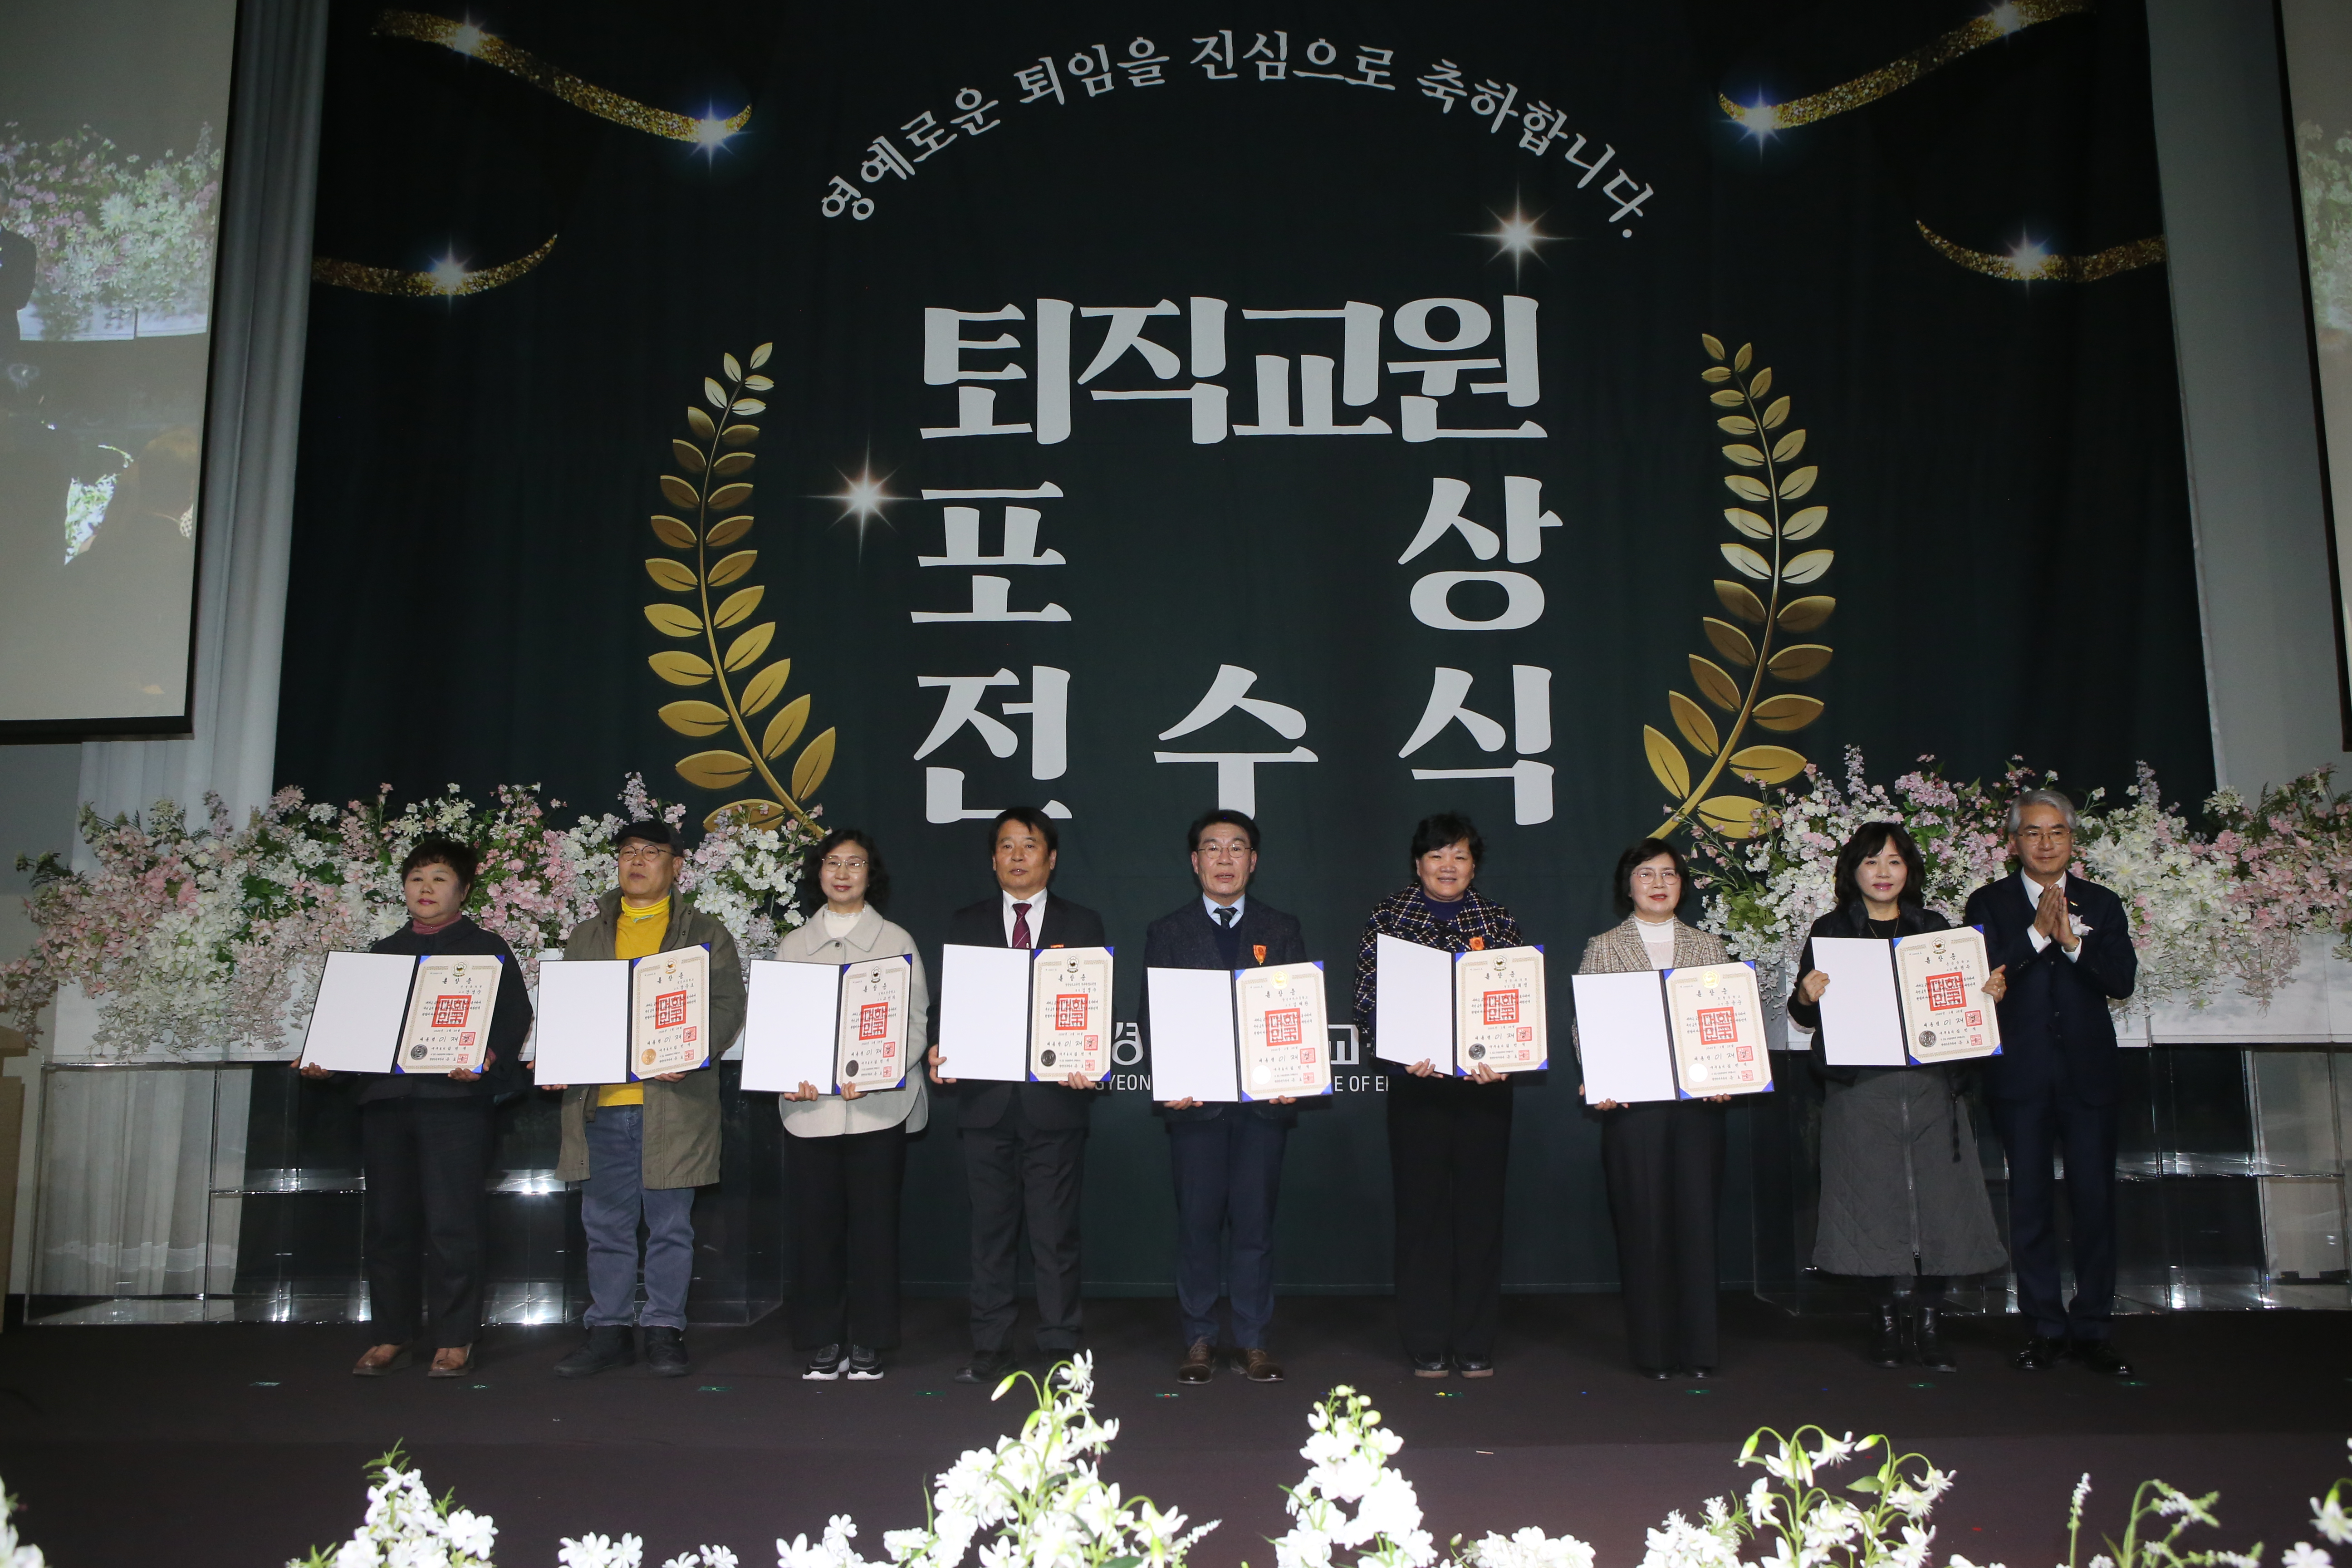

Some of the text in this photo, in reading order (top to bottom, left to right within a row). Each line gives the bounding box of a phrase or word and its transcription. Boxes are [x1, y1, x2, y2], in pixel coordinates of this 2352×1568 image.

[821, 29, 1654, 239] 영예로운 퇴임을 진심으로 축하합니다.
[919, 294, 1548, 445] 퇴직교원
[1349, 1075, 1370, 1092] OF
